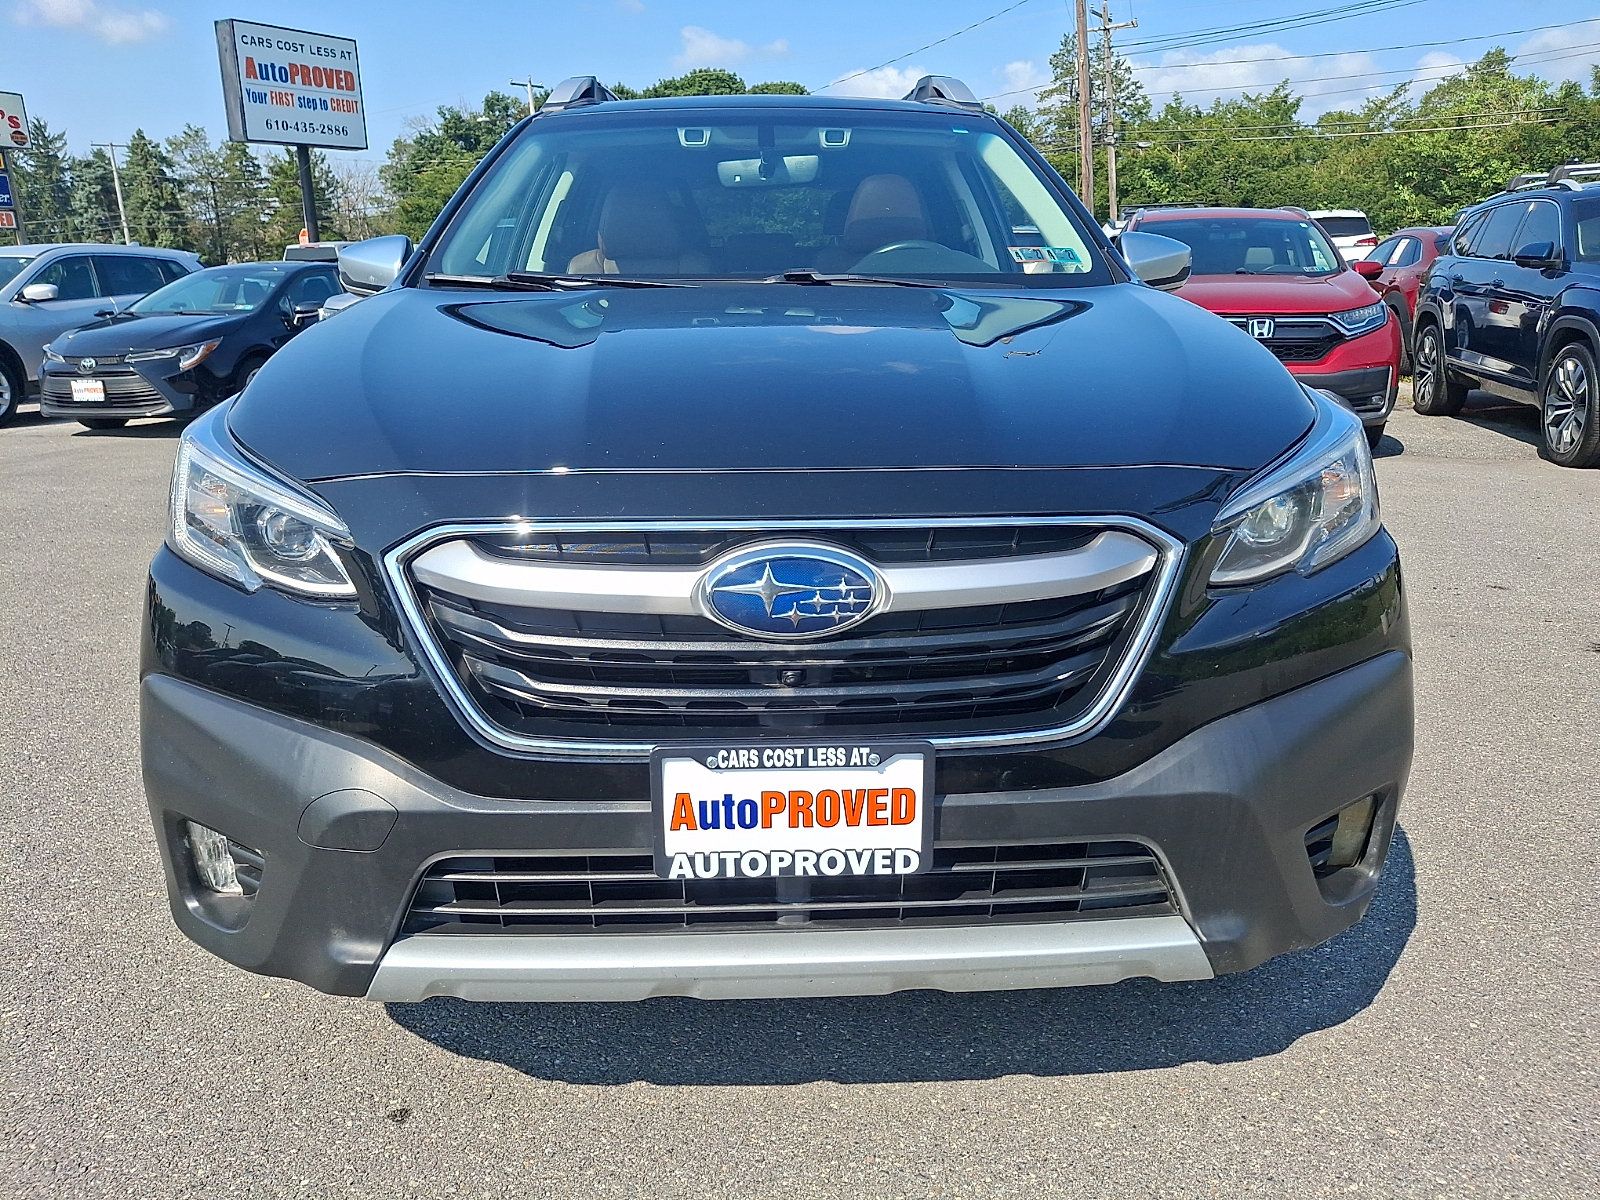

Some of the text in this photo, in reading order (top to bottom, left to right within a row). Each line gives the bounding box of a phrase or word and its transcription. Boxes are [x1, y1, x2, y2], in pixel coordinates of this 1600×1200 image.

[241, 35, 352, 61] CARS COST LESS AT
[245, 56, 356, 92] AutoPROVED
[245, 87, 359, 114] Your FIRST step to CREDIT
[265, 118, 349, 137] 610-435-2886
[717, 747, 870, 769] CARS COST LESS AT
[670, 787, 916, 831] AutoPROVED
[668, 848, 920, 879] AUTOPROVED
